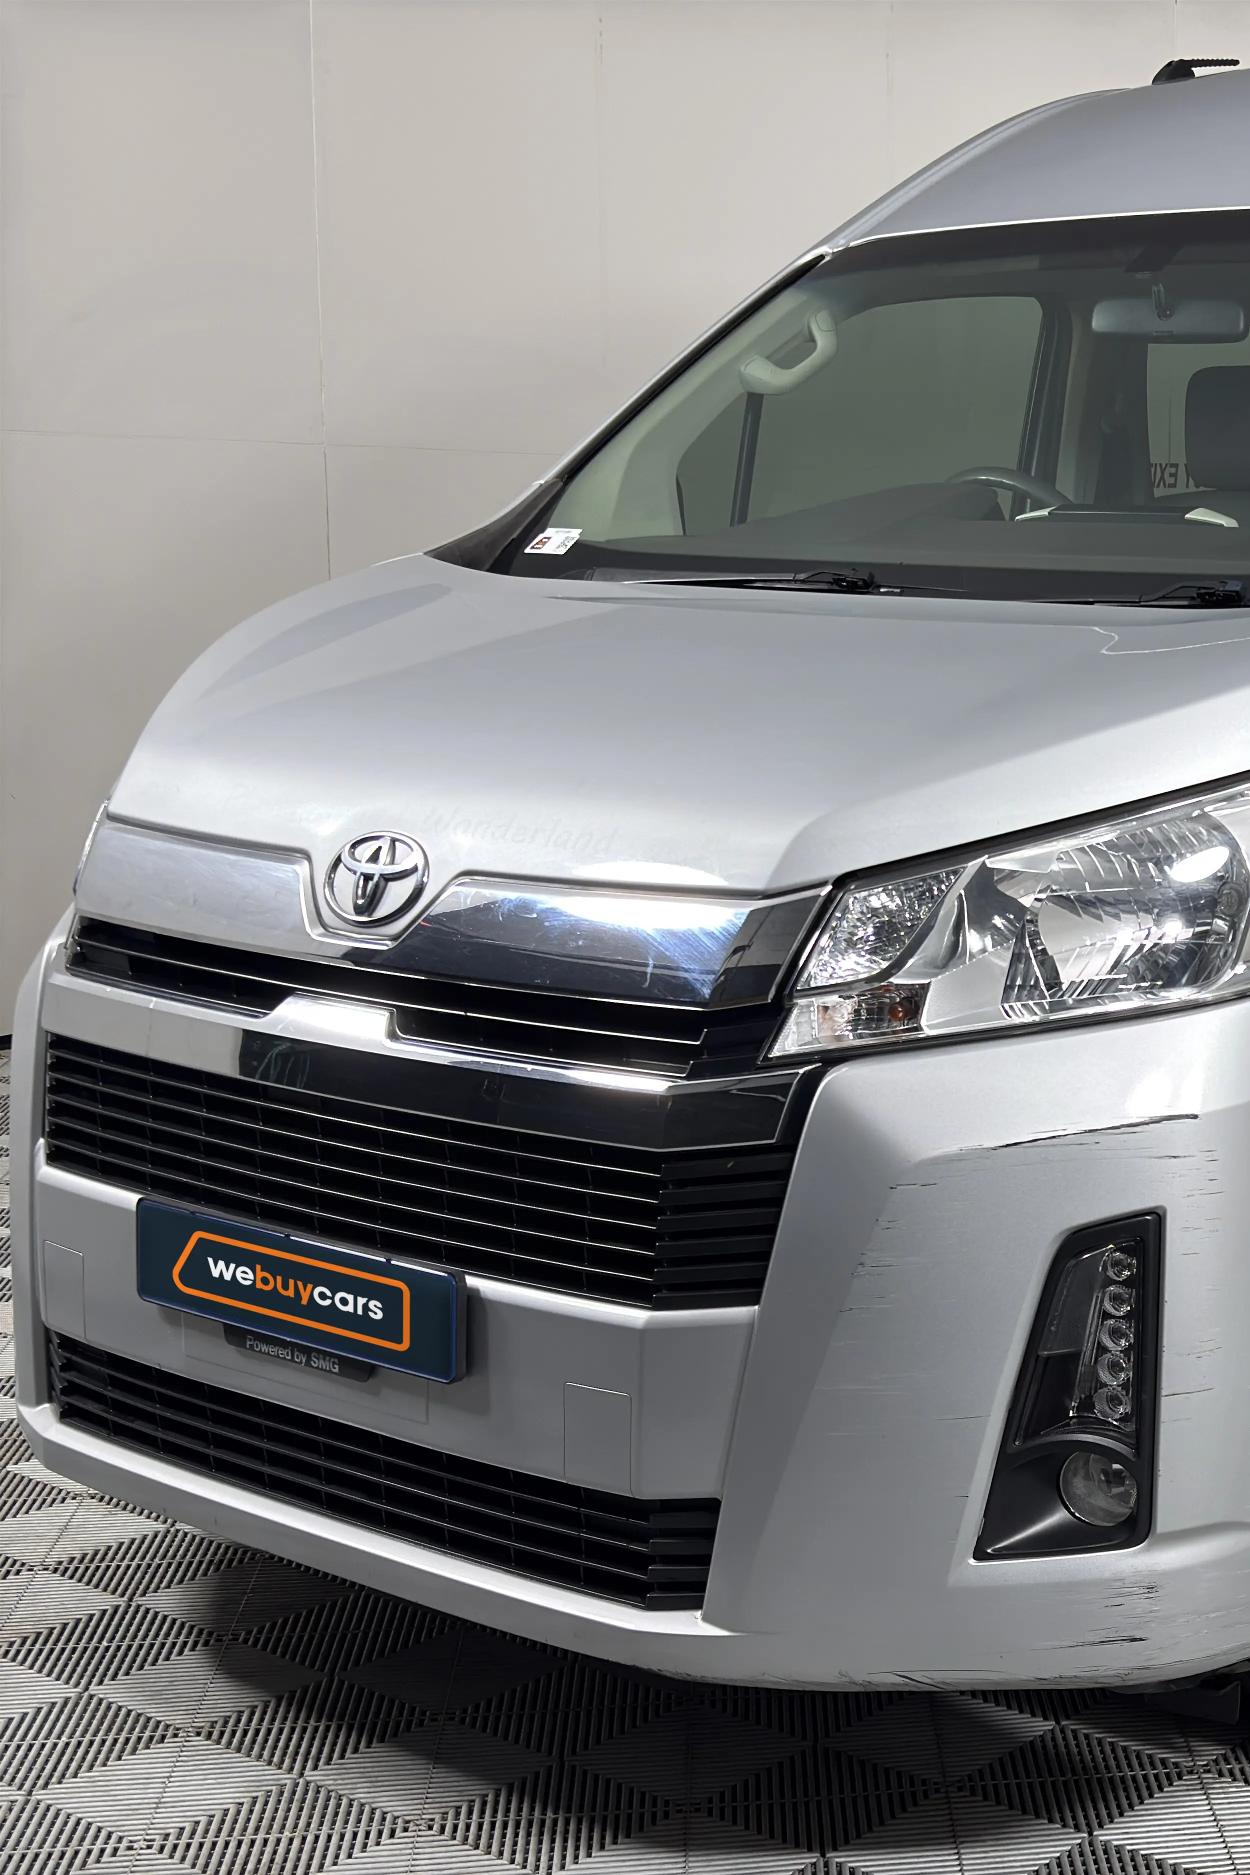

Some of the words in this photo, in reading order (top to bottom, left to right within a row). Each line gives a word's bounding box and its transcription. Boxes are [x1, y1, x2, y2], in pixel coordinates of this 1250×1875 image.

[207, 1256, 384, 1321] webuycars
[246, 1336, 291, 1359] Powered
[294, 1343, 307, 1367] by
[310, 1352, 340, 1374] SMG
